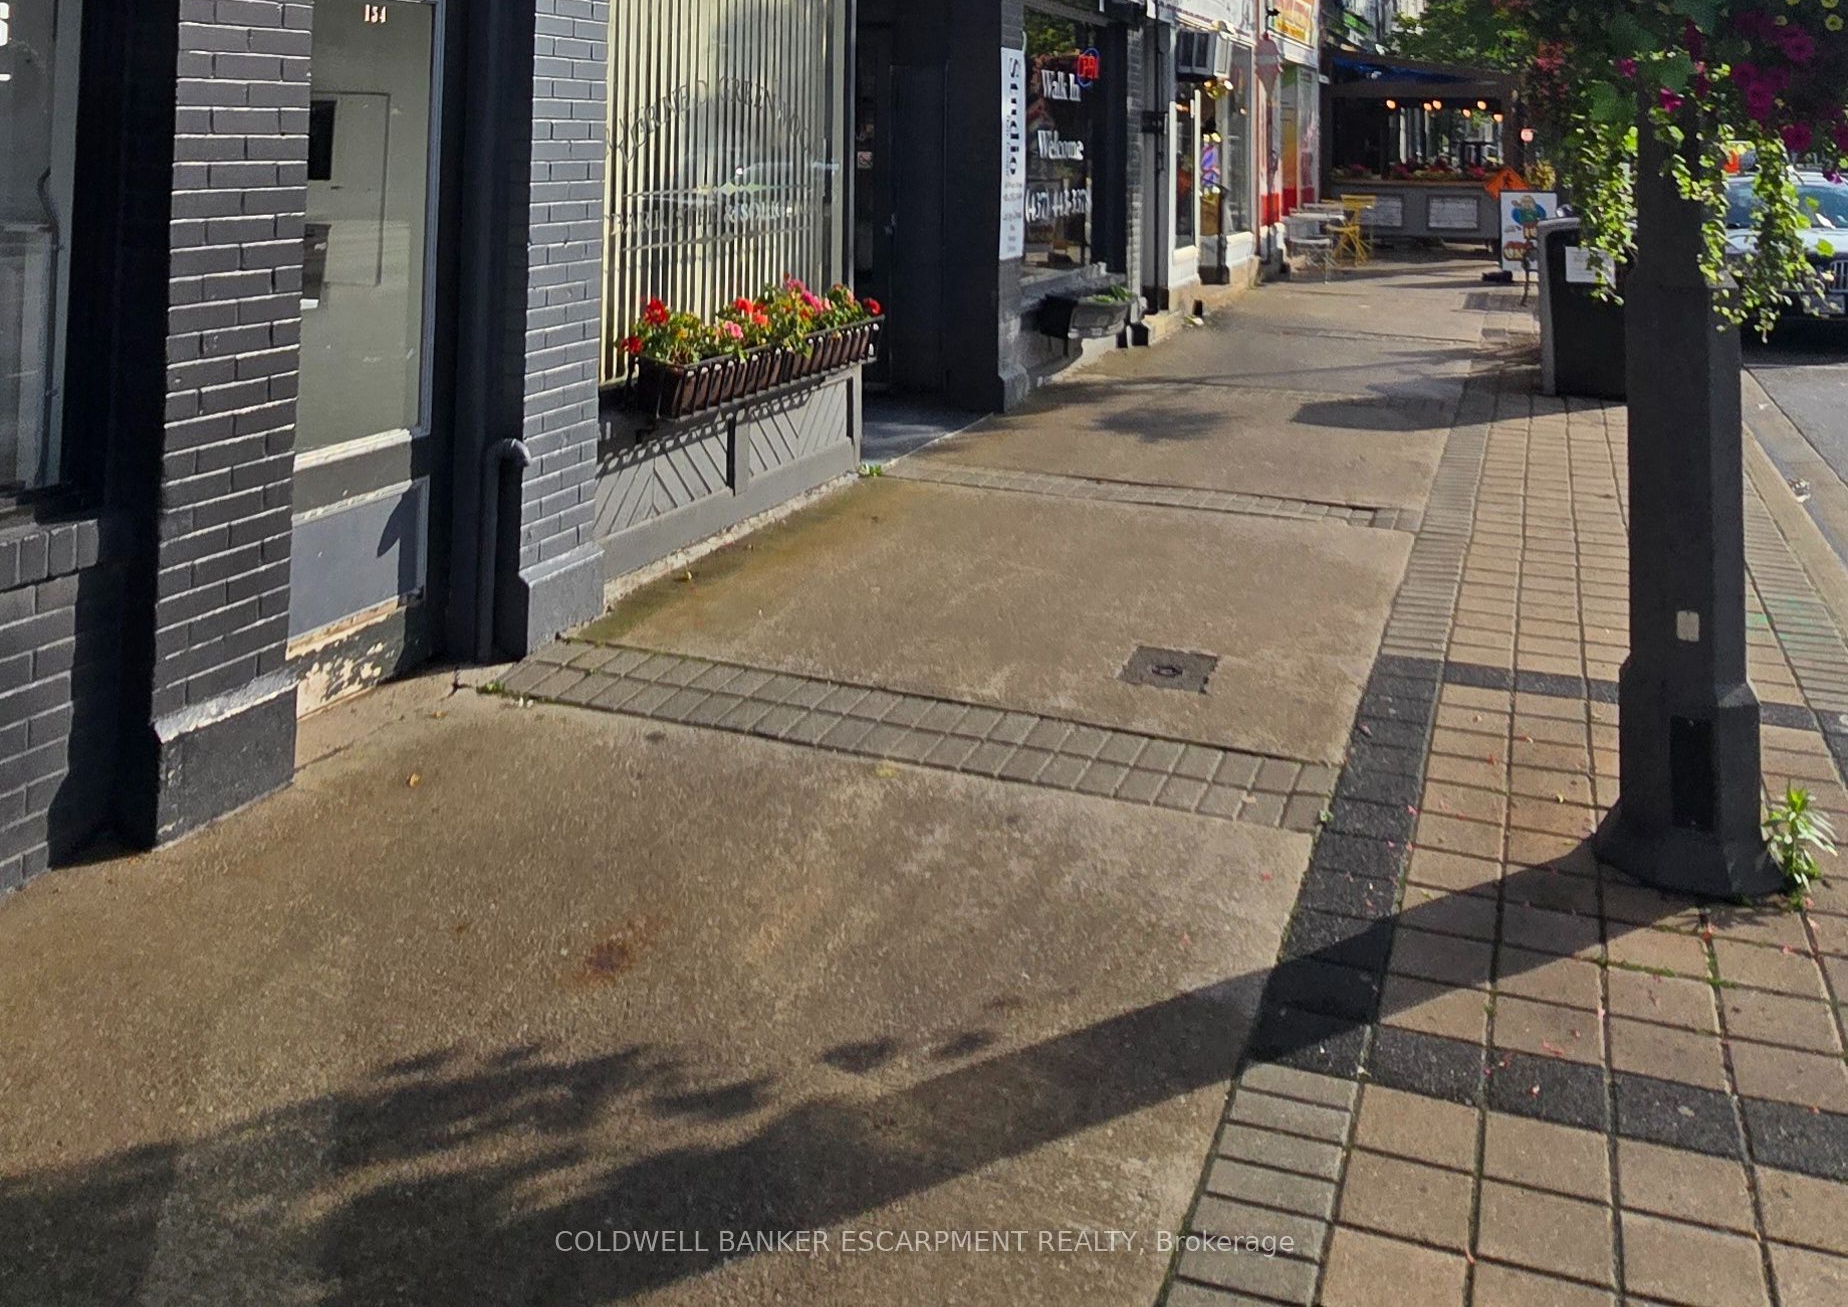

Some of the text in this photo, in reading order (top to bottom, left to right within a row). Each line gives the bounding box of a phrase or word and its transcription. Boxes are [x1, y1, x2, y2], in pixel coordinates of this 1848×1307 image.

[364, 4, 387, 24] 154
[1041, 69, 1081, 101] Walk In
[1038, 130, 1084, 160] Welcome
